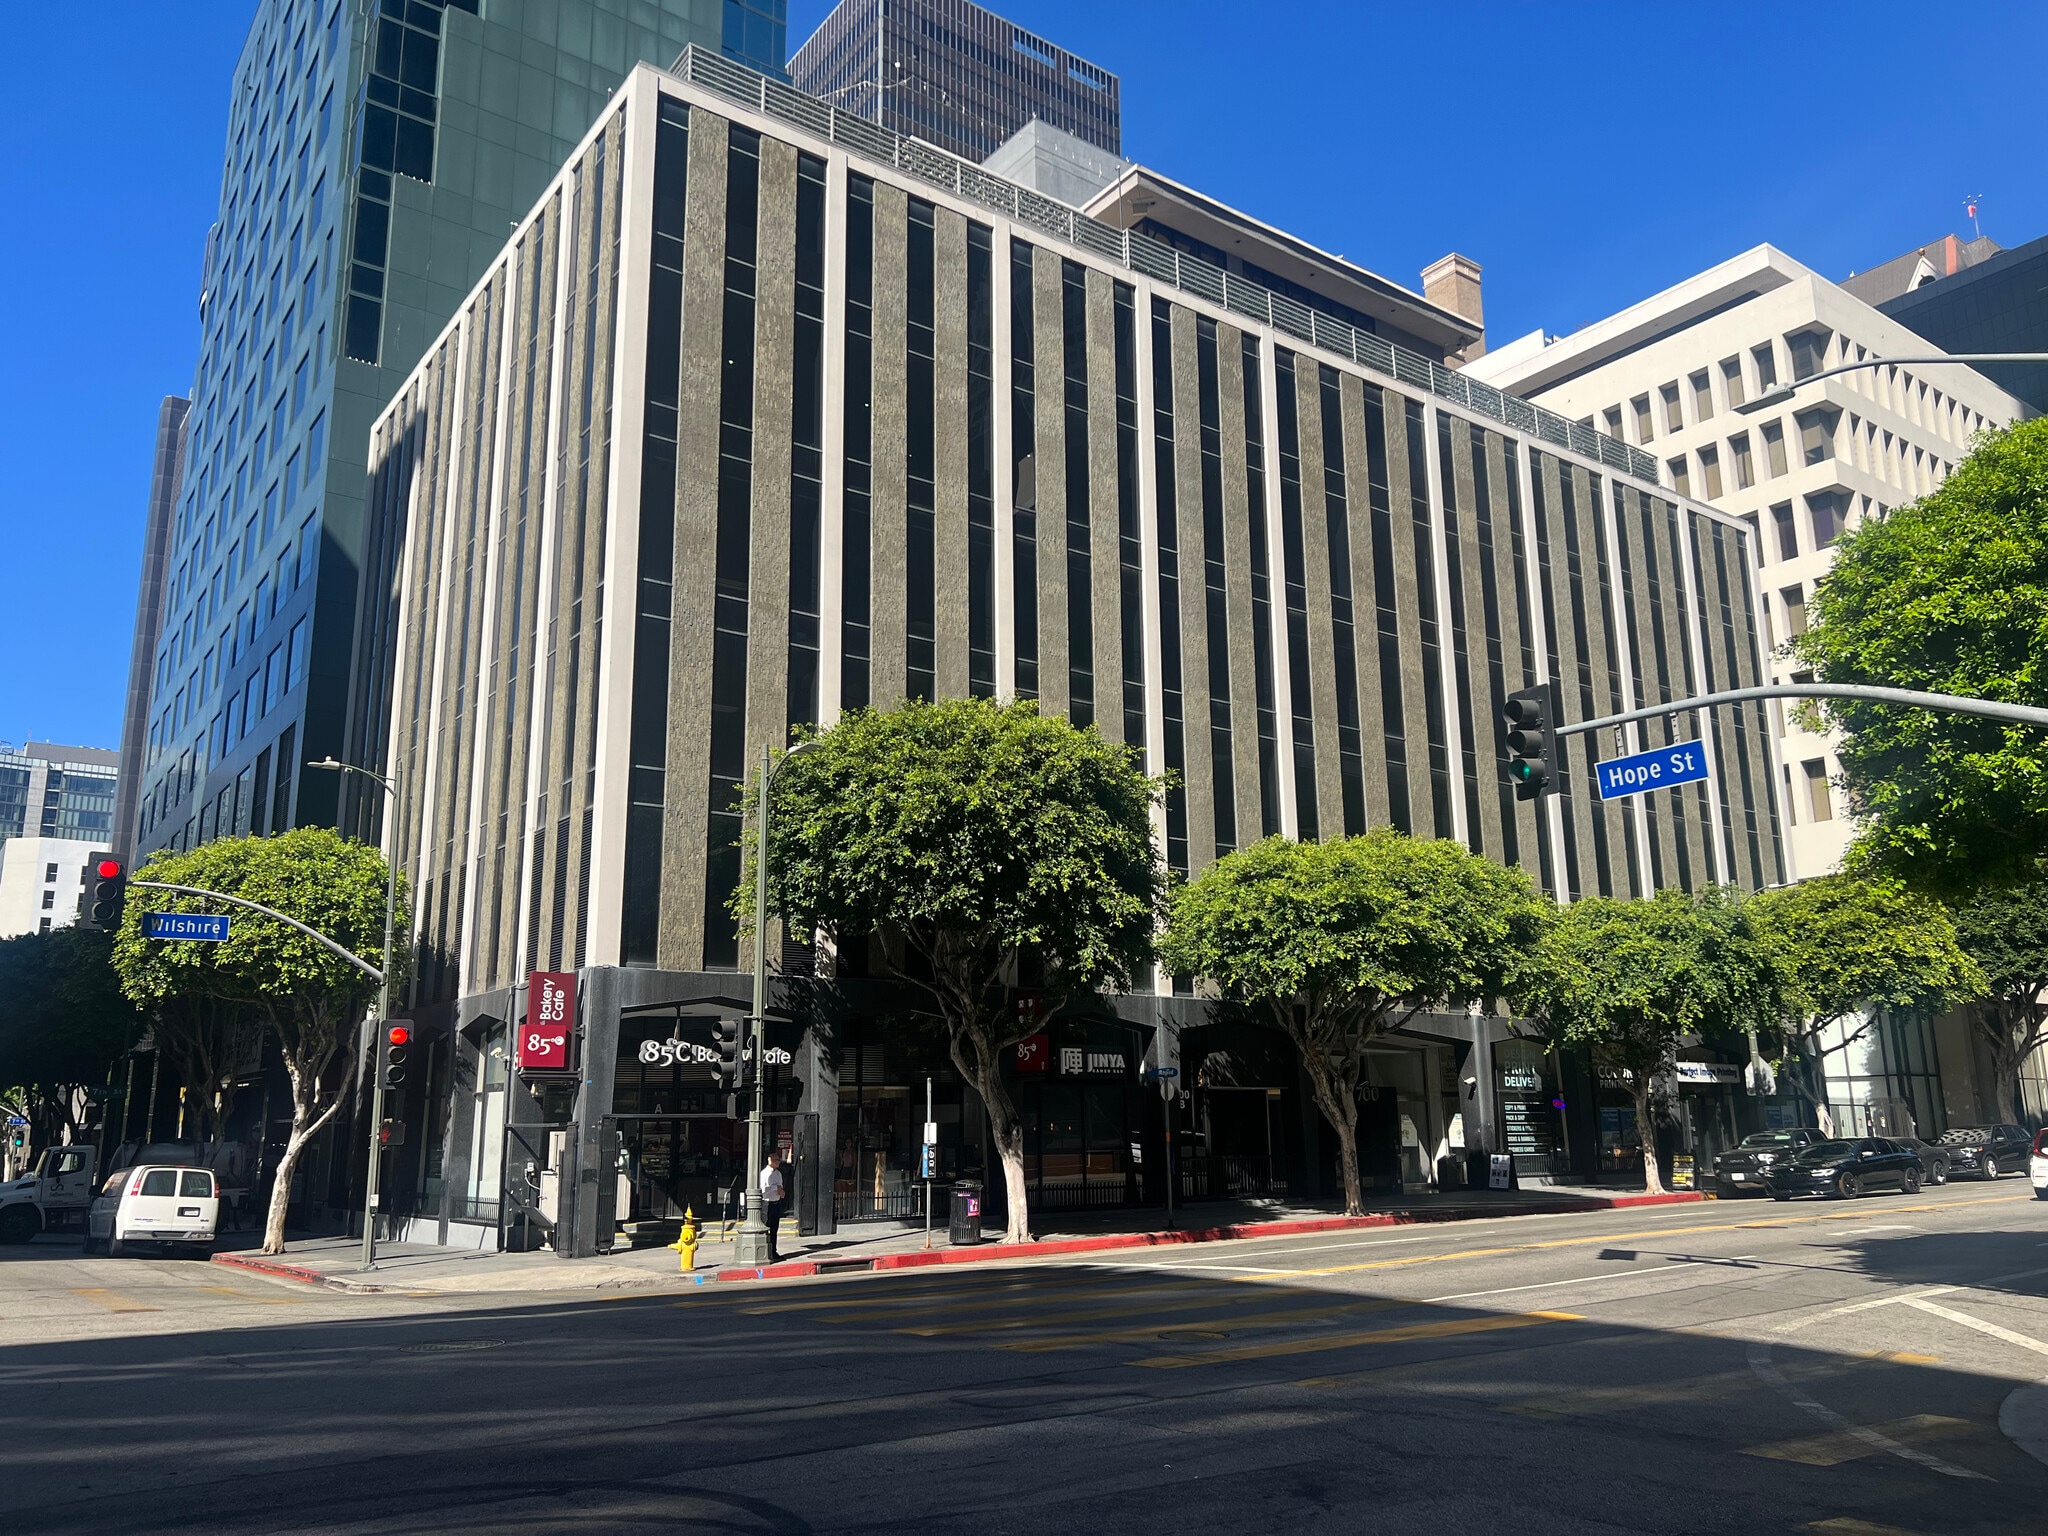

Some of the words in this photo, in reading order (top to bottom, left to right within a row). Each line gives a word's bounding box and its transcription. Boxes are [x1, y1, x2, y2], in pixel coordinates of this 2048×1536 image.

[1609, 763, 1661, 788] Hope
[1670, 752, 1695, 774] St
[151, 918, 221, 934] Wilshire
[539, 978, 556, 1020] Bakery
[551, 990, 565, 1021] Cafe
[762, 1048, 792, 1065] afe
[1086, 1053, 1126, 1073] JINYA
[1504, 1061, 1536, 1075] PRINT
[1357, 1086, 1380, 1102] 700
[654, 1103, 663, 1114] A
